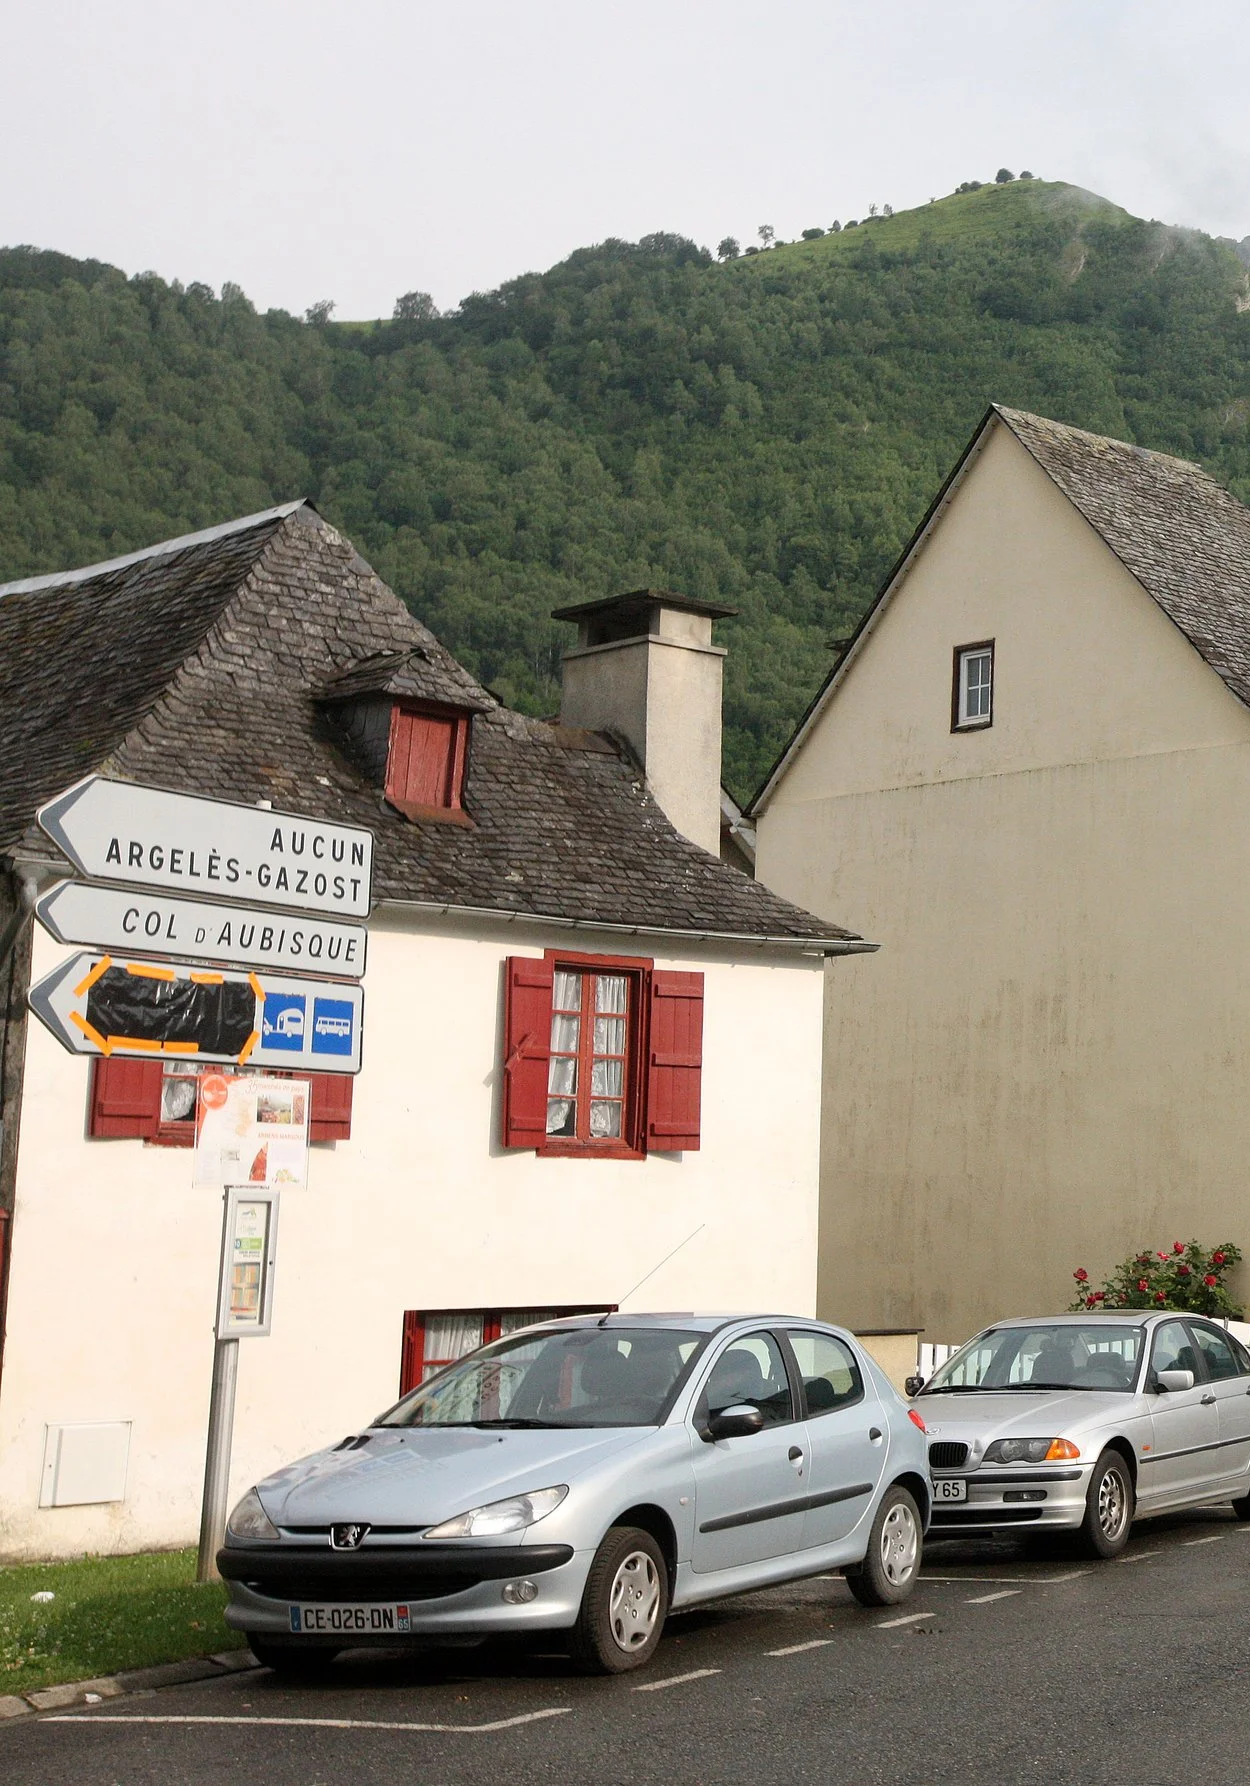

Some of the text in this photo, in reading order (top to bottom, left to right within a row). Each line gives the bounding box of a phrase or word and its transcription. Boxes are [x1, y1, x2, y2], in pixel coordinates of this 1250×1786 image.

[270, 828, 364, 866] AUCUN
[106, 838, 361, 901] ARGELÈS-GAZOST
[122, 908, 177, 940] COL
[943, 1482, 960, 1498] 65
[303, 1608, 394, 1629] CE-026-DN
[398, 1618, 409, 1630] 65
